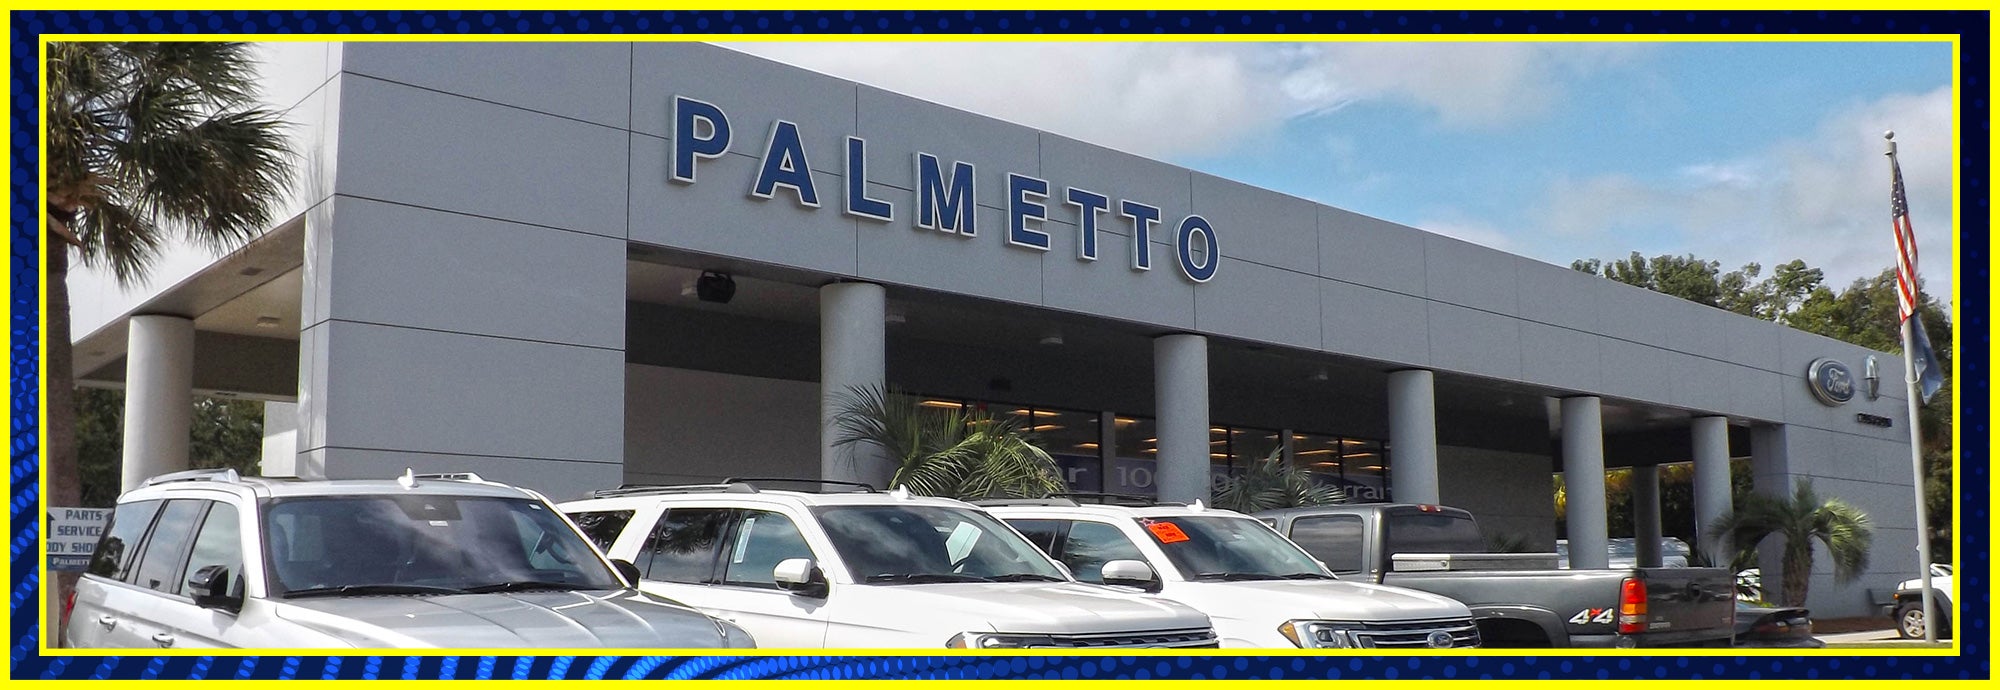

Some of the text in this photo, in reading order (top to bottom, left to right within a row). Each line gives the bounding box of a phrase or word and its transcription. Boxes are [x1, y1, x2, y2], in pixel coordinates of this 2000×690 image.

[668, 94, 1221, 283] PALMETTO
[1827, 368, 1850, 394] Ford
[1116, 466, 1157, 488] 10
[65, 509, 102, 520] PARTS
[57, 525, 101, 536] SERVICE
[47, 542, 66, 552] ODY
